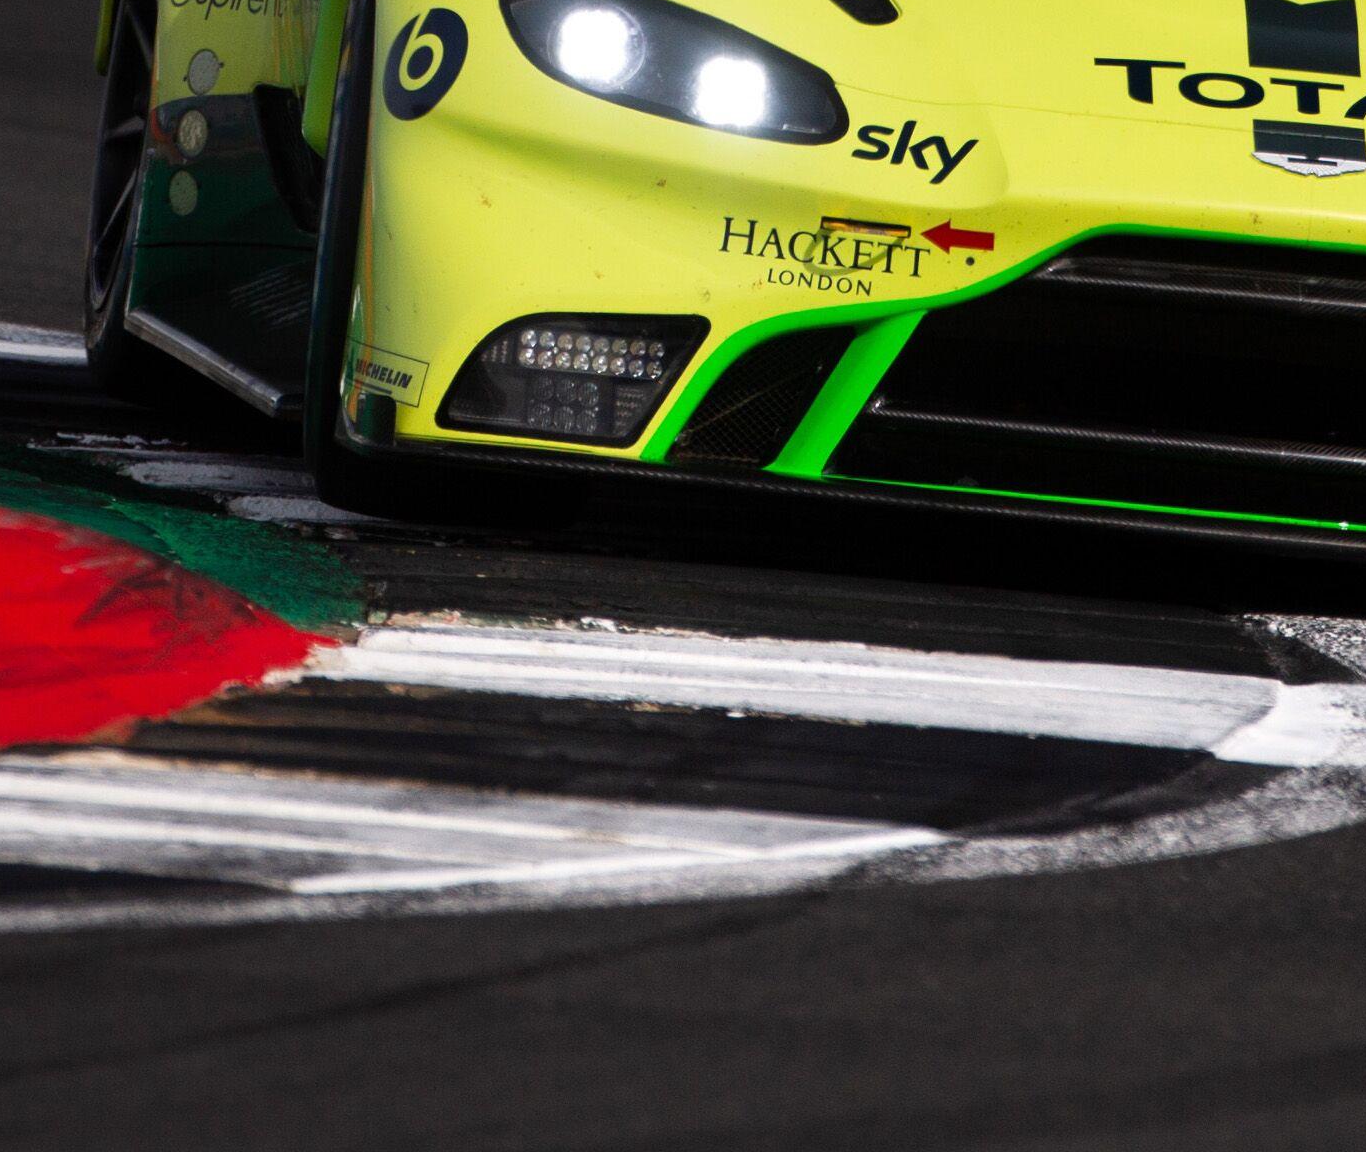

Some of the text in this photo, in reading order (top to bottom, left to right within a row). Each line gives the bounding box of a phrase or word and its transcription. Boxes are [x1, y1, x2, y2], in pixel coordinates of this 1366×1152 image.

[851, 119, 980, 185] sky
[718, 215, 931, 278] HACKETT
[766, 267, 873, 297] LONDON
[355, 358, 413, 389] MICHELIN
